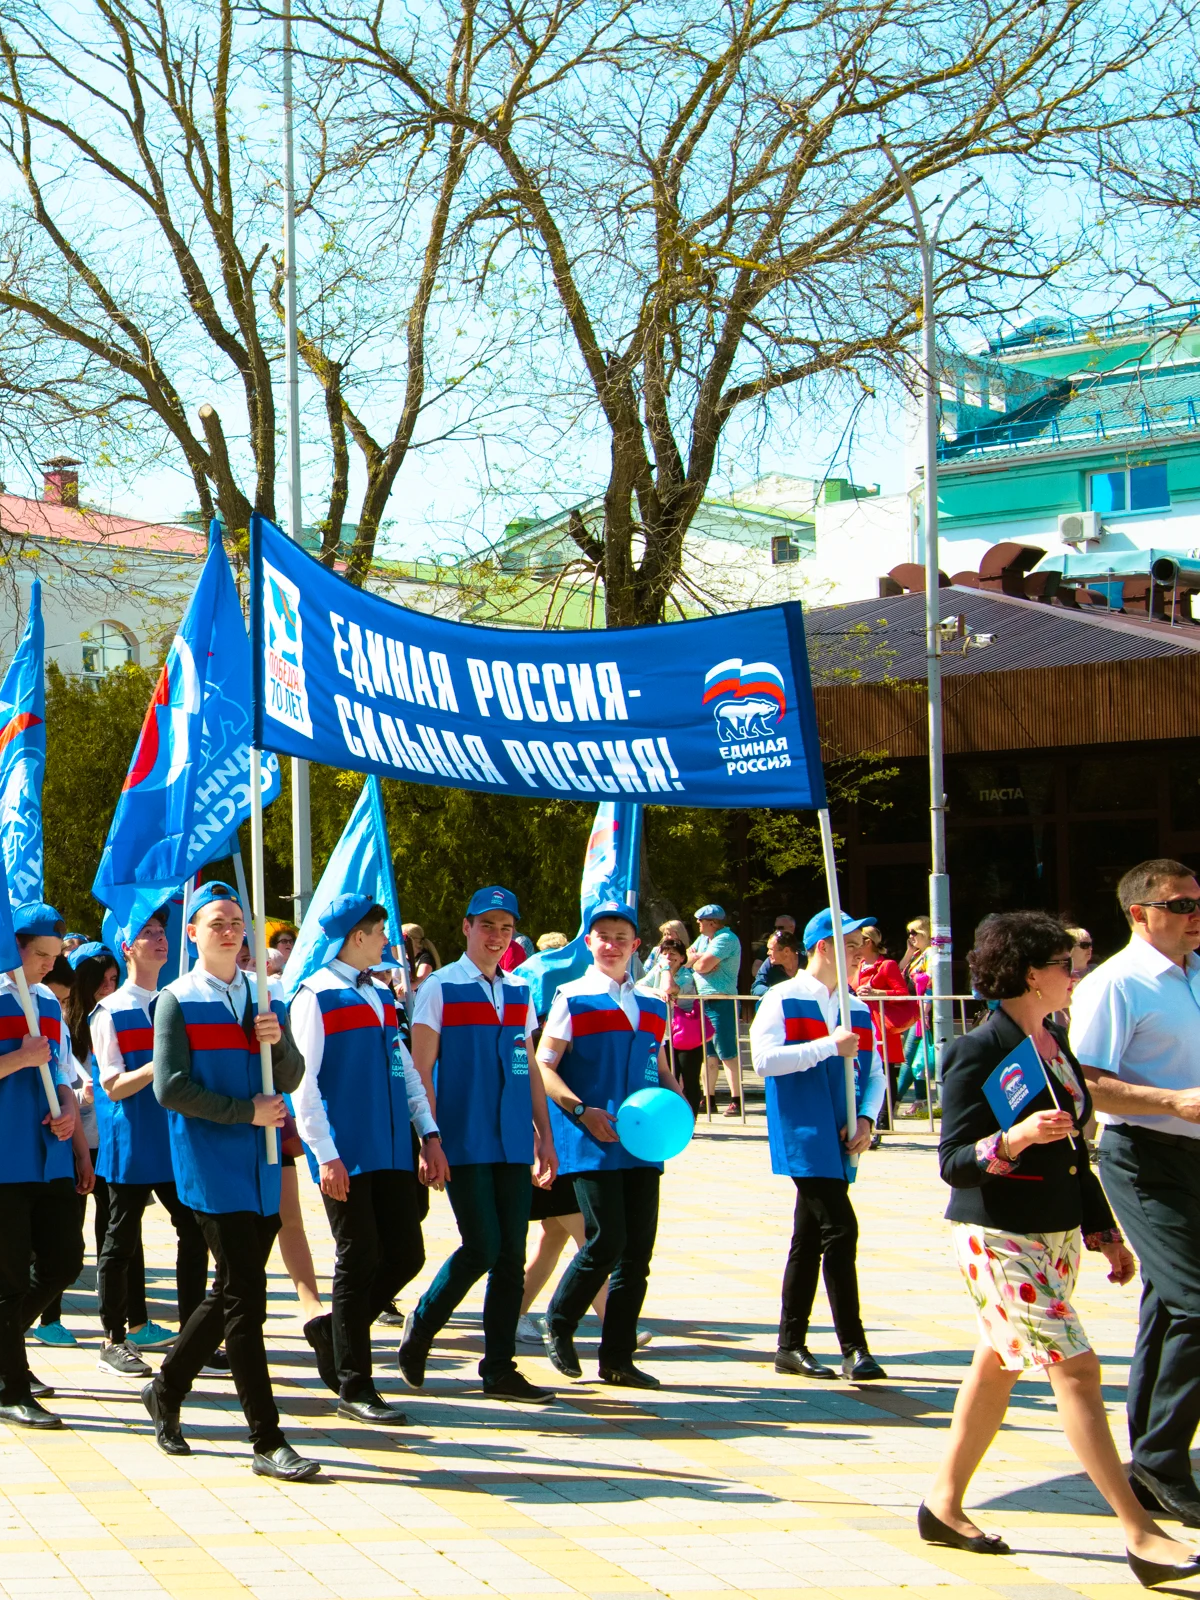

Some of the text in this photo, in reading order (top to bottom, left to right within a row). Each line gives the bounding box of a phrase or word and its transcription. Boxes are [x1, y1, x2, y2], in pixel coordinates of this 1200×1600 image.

[330, 611, 643, 722] ЕДИНАЯ РОССИЯ-
[270, 678, 304, 722] 70 ЛЕТ
[334, 694, 686, 793] СИЛЬНАЯ РОССИЯ!
[719, 737, 788, 759] ЕДИНАЯ
[727, 754, 791, 776] РОССИЯ
[979, 787, 1024, 801] ПАСТА
